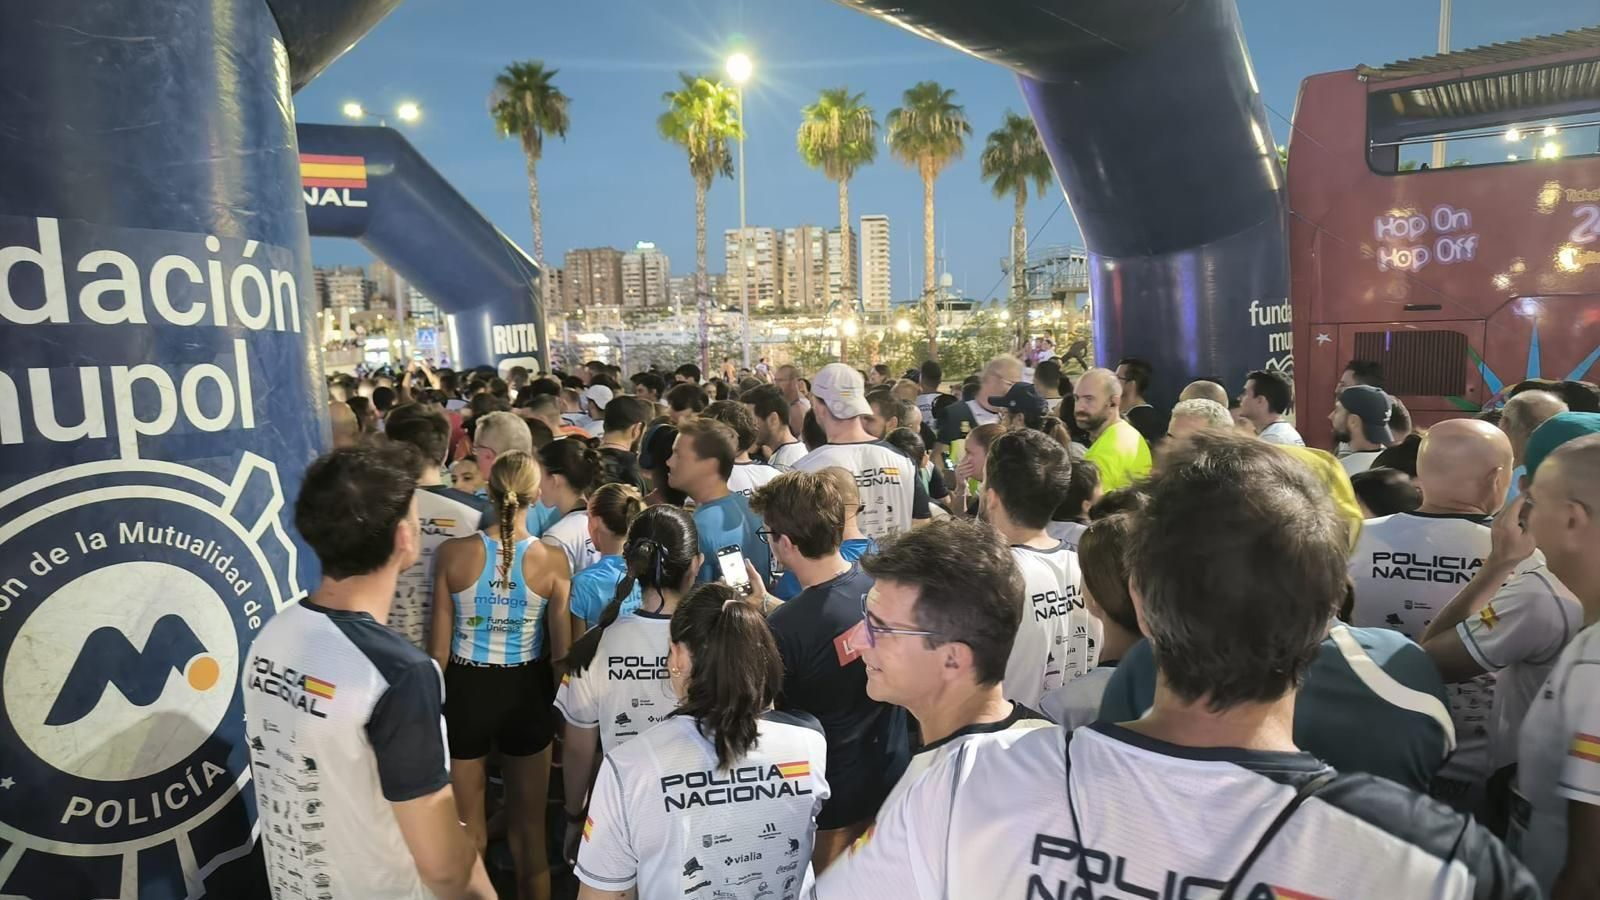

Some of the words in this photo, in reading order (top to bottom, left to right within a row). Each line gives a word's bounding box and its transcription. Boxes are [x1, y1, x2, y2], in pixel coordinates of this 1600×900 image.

[1434, 206, 1470, 231] On
[1436, 235, 1477, 262] Off
[0, 217, 300, 333] dación
[493, 323, 538, 354] RUTA
[29, 546, 70, 577] de
[75, 531, 108, 554] la
[119, 521, 252, 597] Mutualidad
[243, 600, 263, 631] de
[488, 579, 518, 590] vie
[608, 669, 671, 680] NACIO
[60, 760, 226, 828] POLICÍA
[664, 780, 813, 812] NACIONAL
[735, 852, 762, 864] vialia
